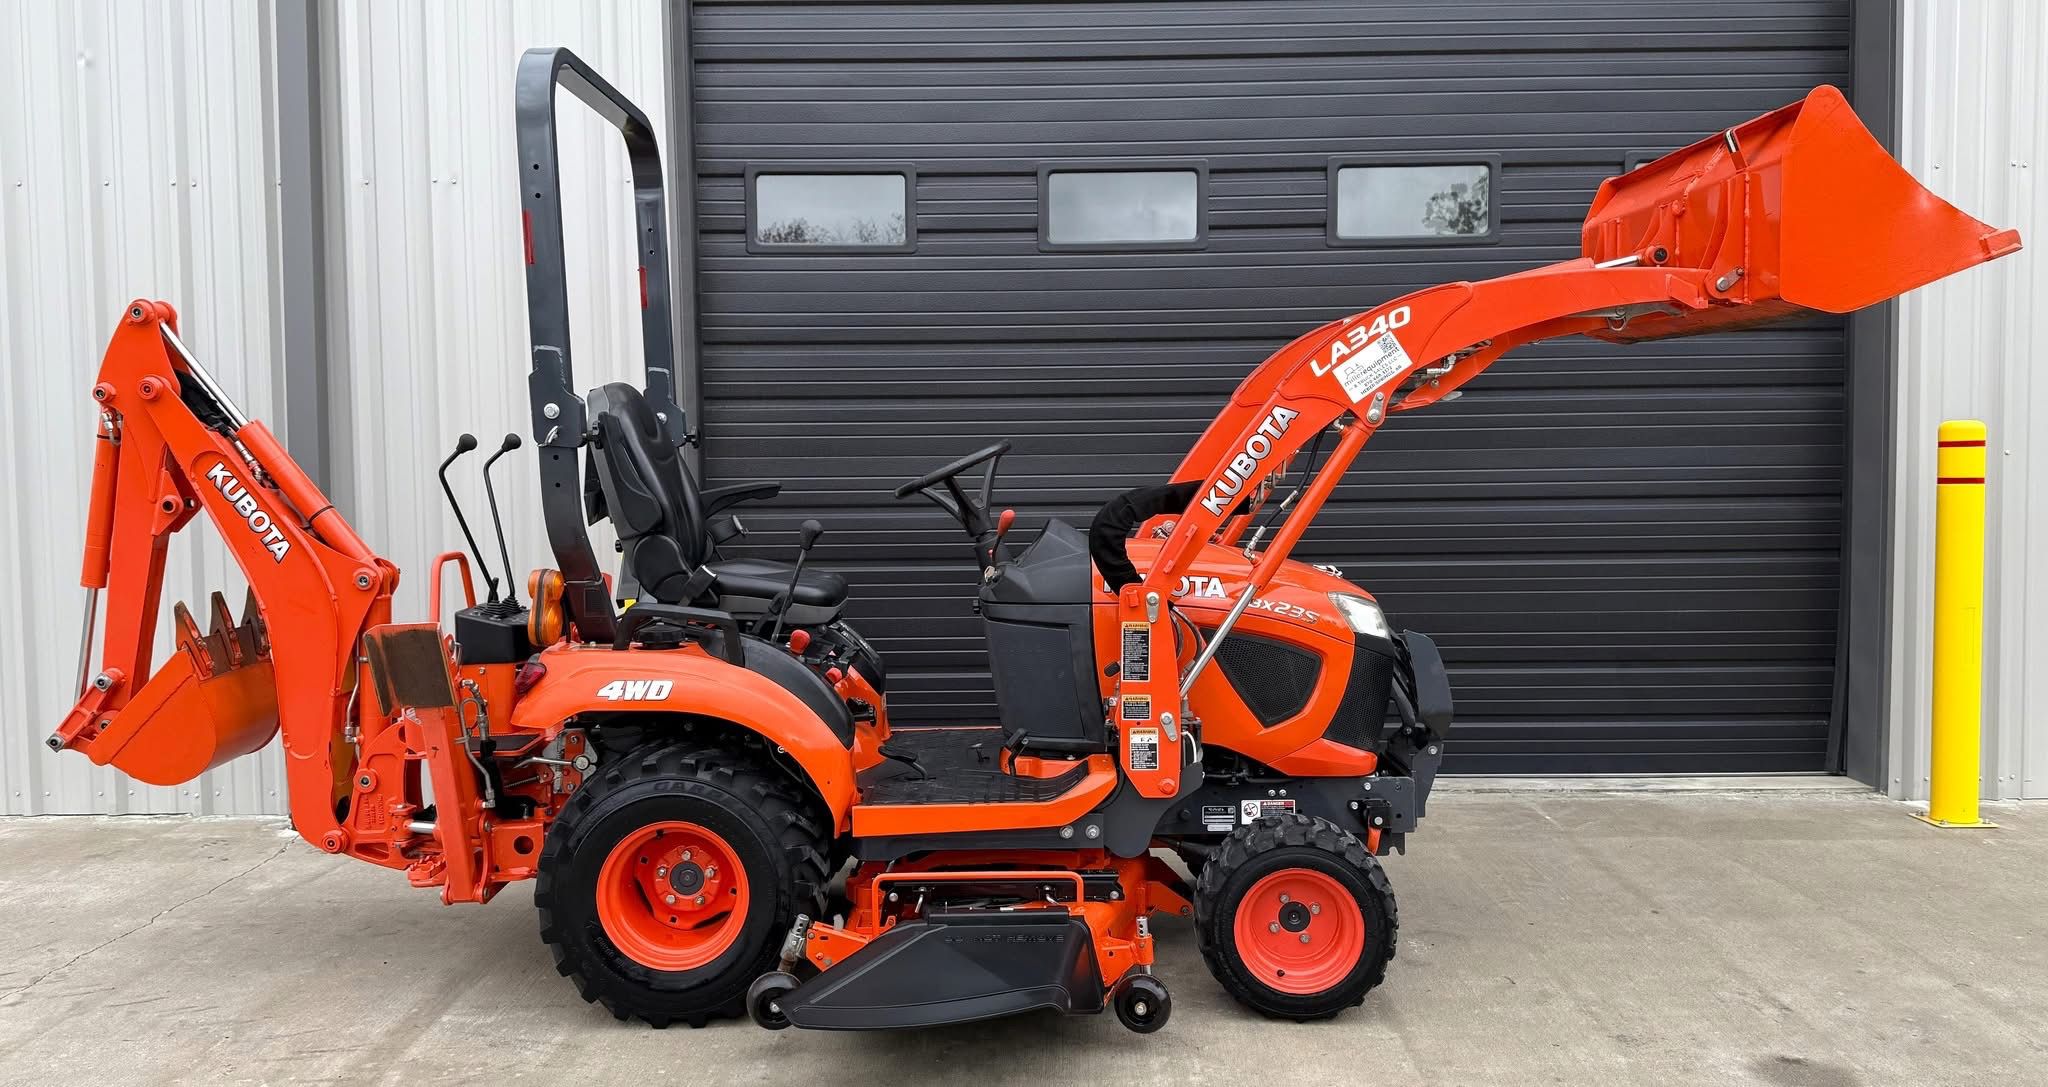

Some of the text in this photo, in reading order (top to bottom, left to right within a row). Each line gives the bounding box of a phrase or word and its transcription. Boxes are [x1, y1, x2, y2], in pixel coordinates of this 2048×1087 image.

[1310, 305, 1411, 377] LA340
[1200, 405, 1300, 517] KUBOTA
[205, 461, 292, 564] KUBOTA
[596, 680, 674, 701] 4WD
